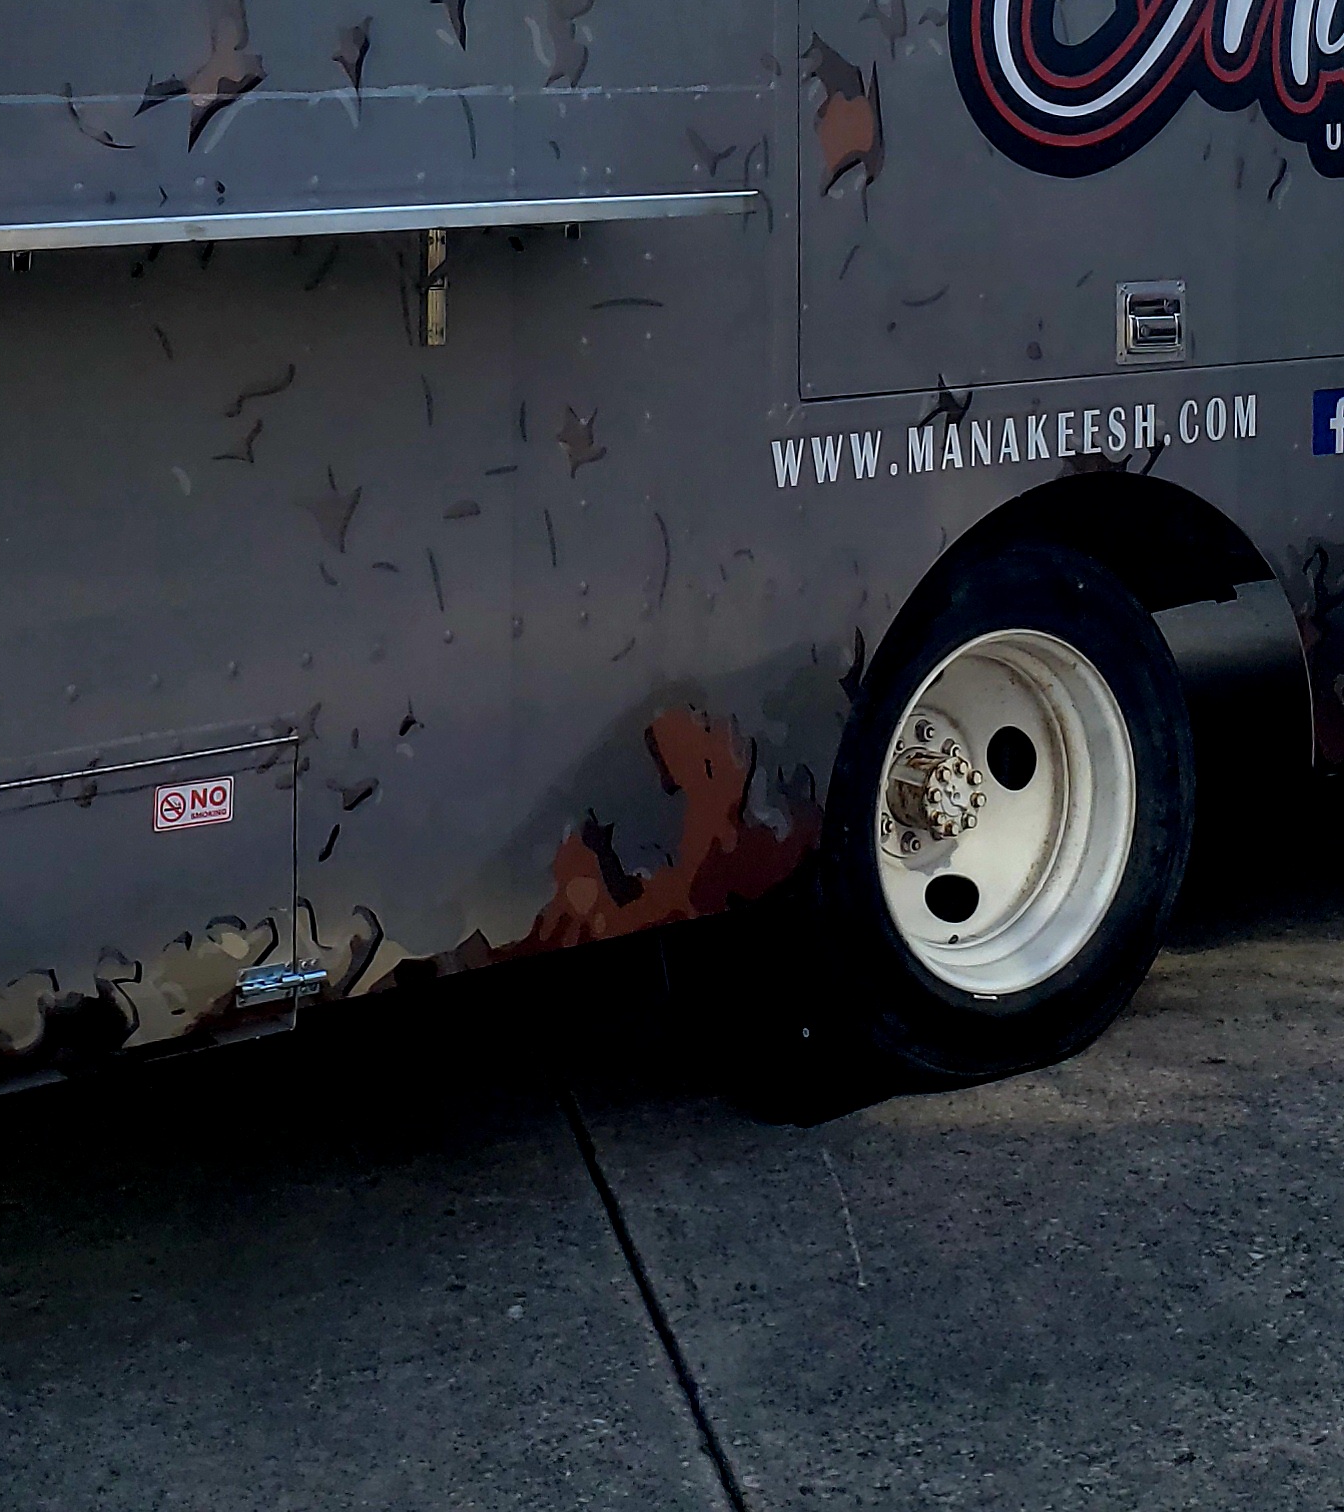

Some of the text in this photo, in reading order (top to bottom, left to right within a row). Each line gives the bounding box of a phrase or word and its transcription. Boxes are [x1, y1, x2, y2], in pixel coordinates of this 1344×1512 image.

[771, 394, 1258, 488] WWW.MANAKEESH.COM
[190, 786, 227, 810] NO
[191, 808, 227, 819] SMOKING
